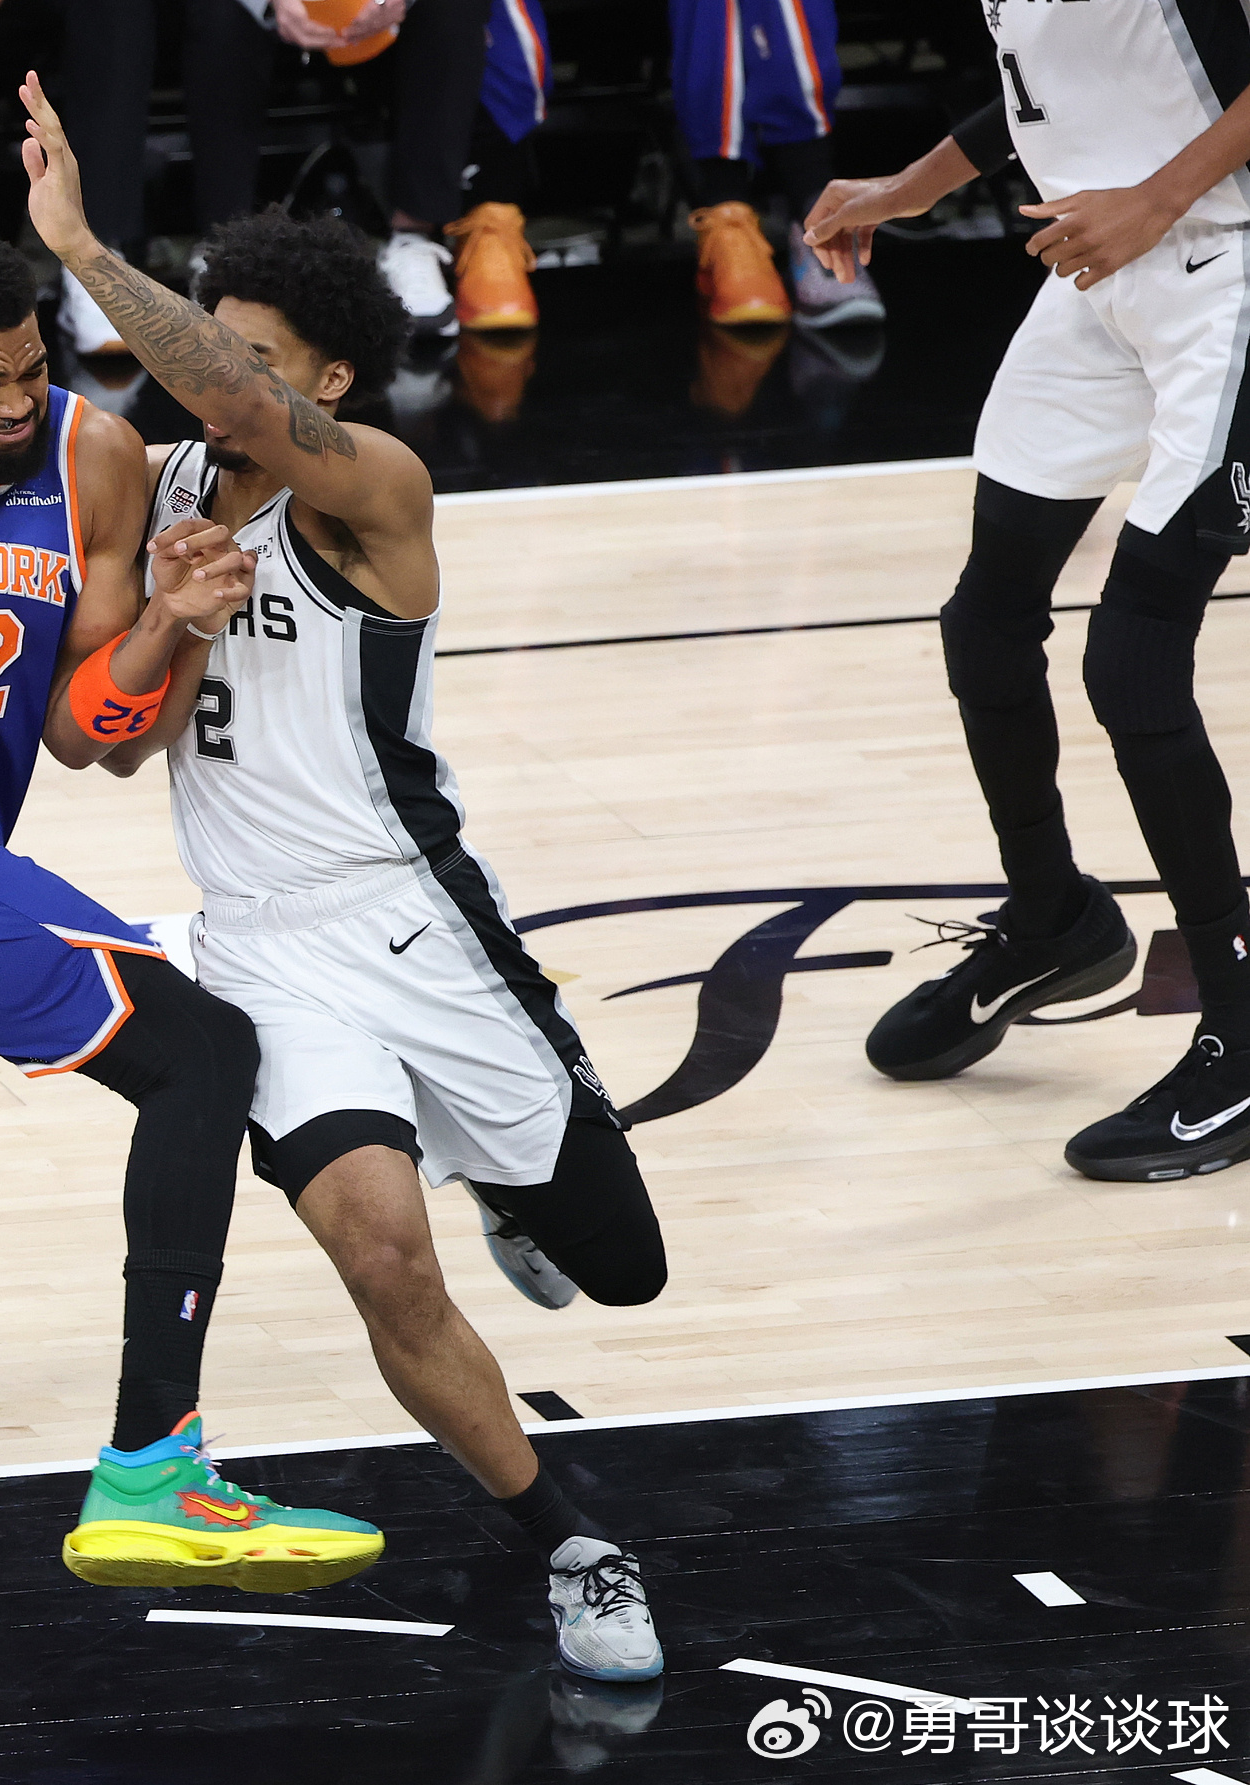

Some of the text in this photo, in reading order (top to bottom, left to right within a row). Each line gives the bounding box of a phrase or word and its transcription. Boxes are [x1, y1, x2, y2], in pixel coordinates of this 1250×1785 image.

[175, 488, 196, 502] USA
[167, 497, 191, 513] 250
[229, 593, 298, 642] RS
